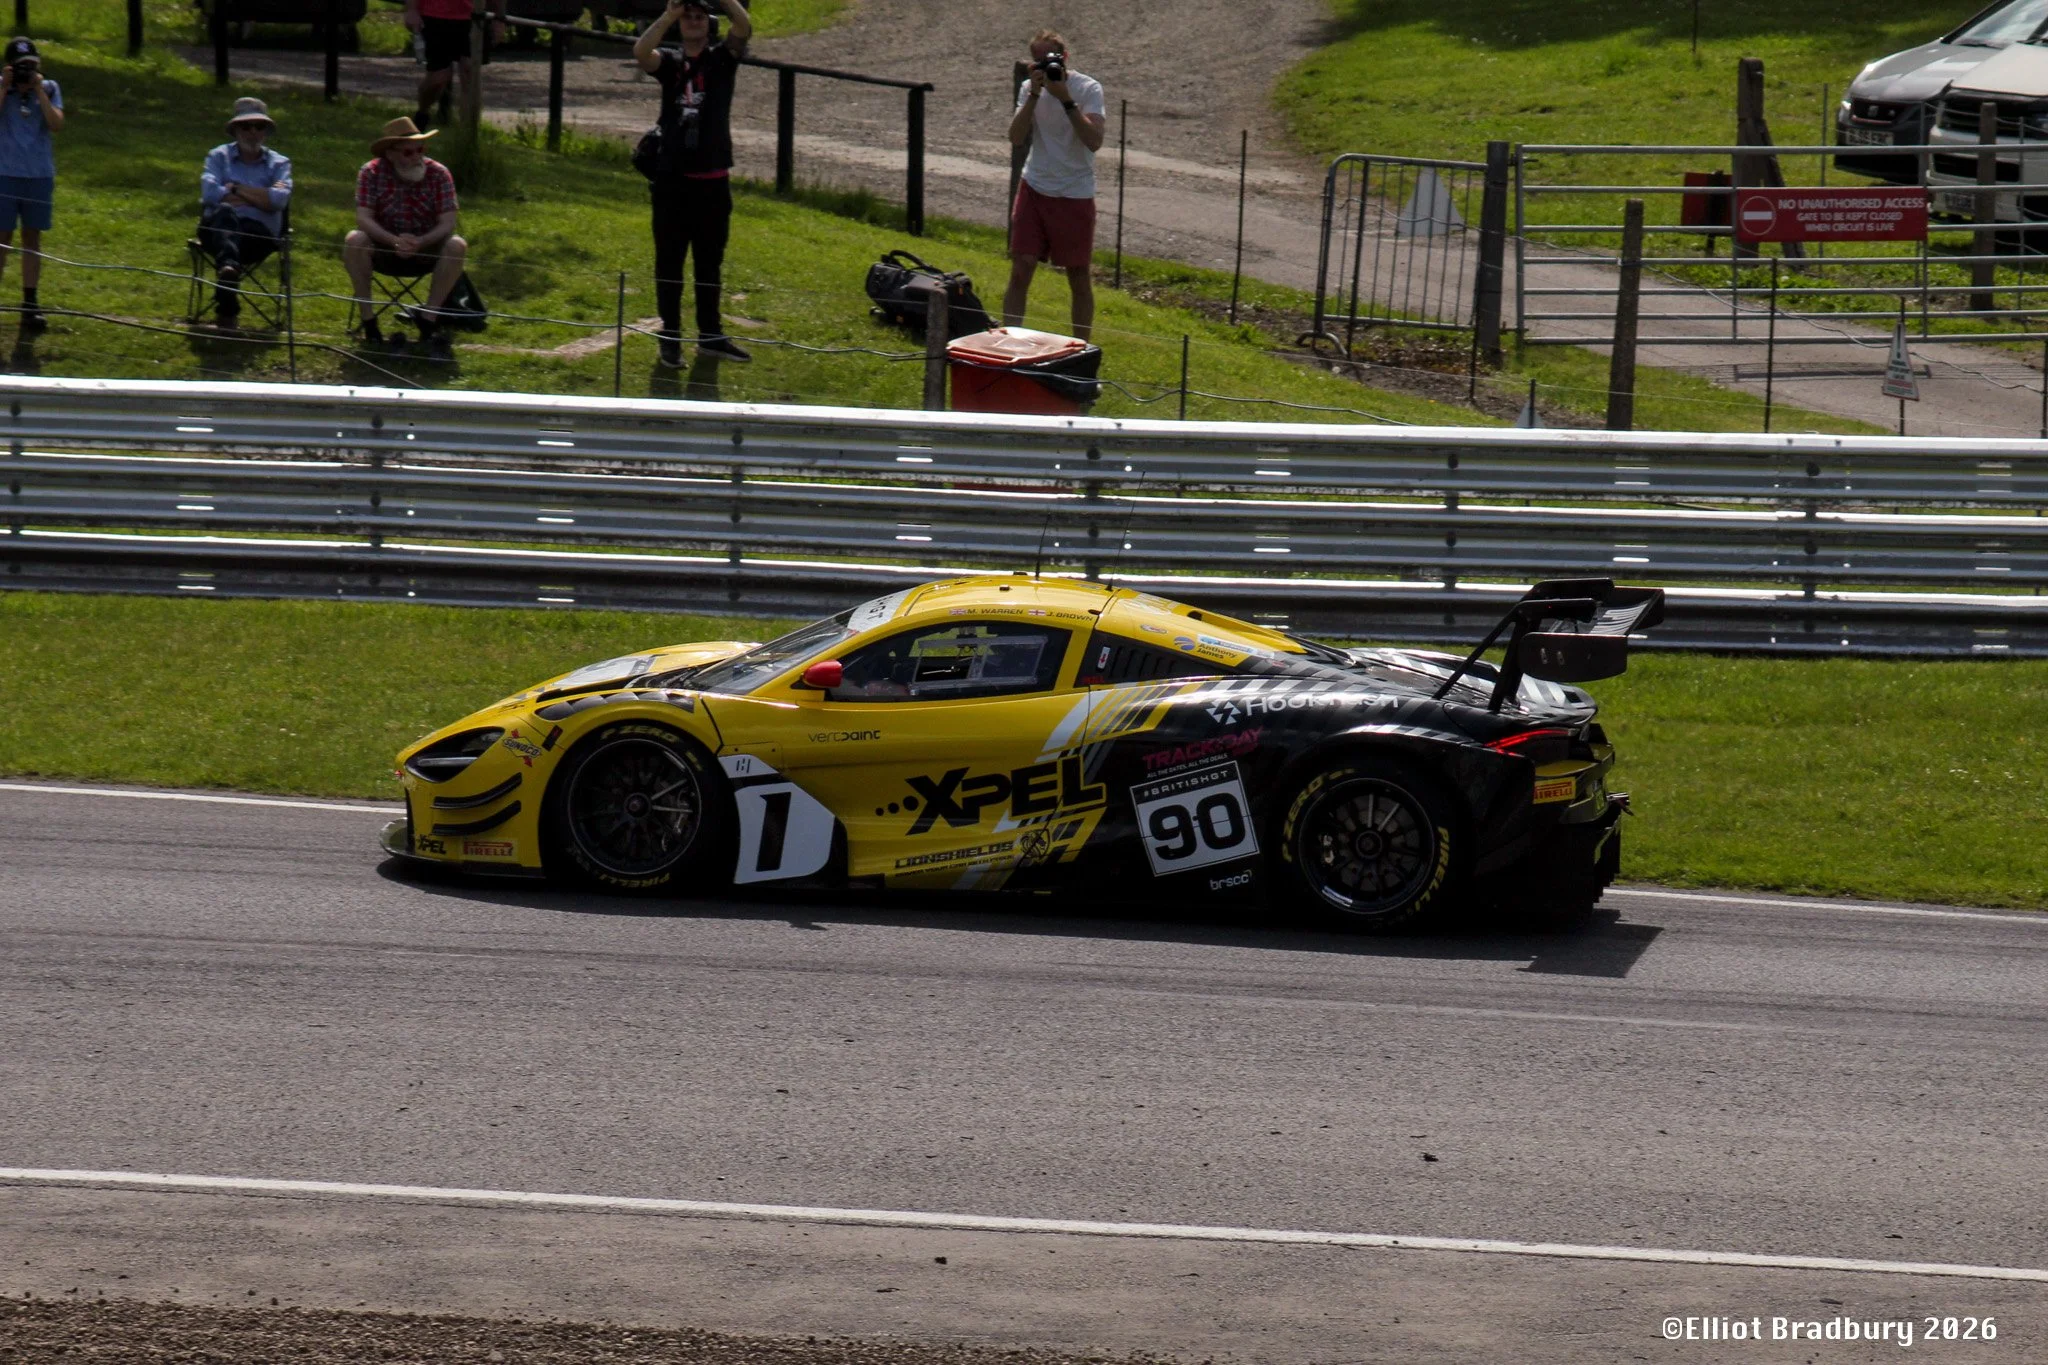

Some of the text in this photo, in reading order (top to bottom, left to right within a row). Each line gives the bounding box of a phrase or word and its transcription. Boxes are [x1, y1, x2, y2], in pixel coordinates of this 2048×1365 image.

[1778, 197, 1925, 209] NO UNAUTHORISED ACCESS
[1796, 212, 1903, 221] GATE TO BE KEPT CLOSED
[1805, 223, 1895, 232] WHEN CIRCUIT IS LIVE
[1197, 648, 1224, 660] James
[1200, 644, 1238, 658] Anthony
[619, 725, 680, 743] ZERO
[504, 739, 541, 757] SUNOCO
[1143, 770, 1229, 798] #BRITISHGT
[1534, 781, 1573, 800] PIRELLI
[904, 754, 1104, 836] XPEL
[1148, 792, 1246, 861] 90
[418, 834, 446, 855] XPEL
[463, 841, 513, 856] PIRELLI
[895, 841, 1014, 868] LIONSHIELDS
[600, 872, 671, 888] PIRELLI
[1210, 871, 1250, 890] brscc
